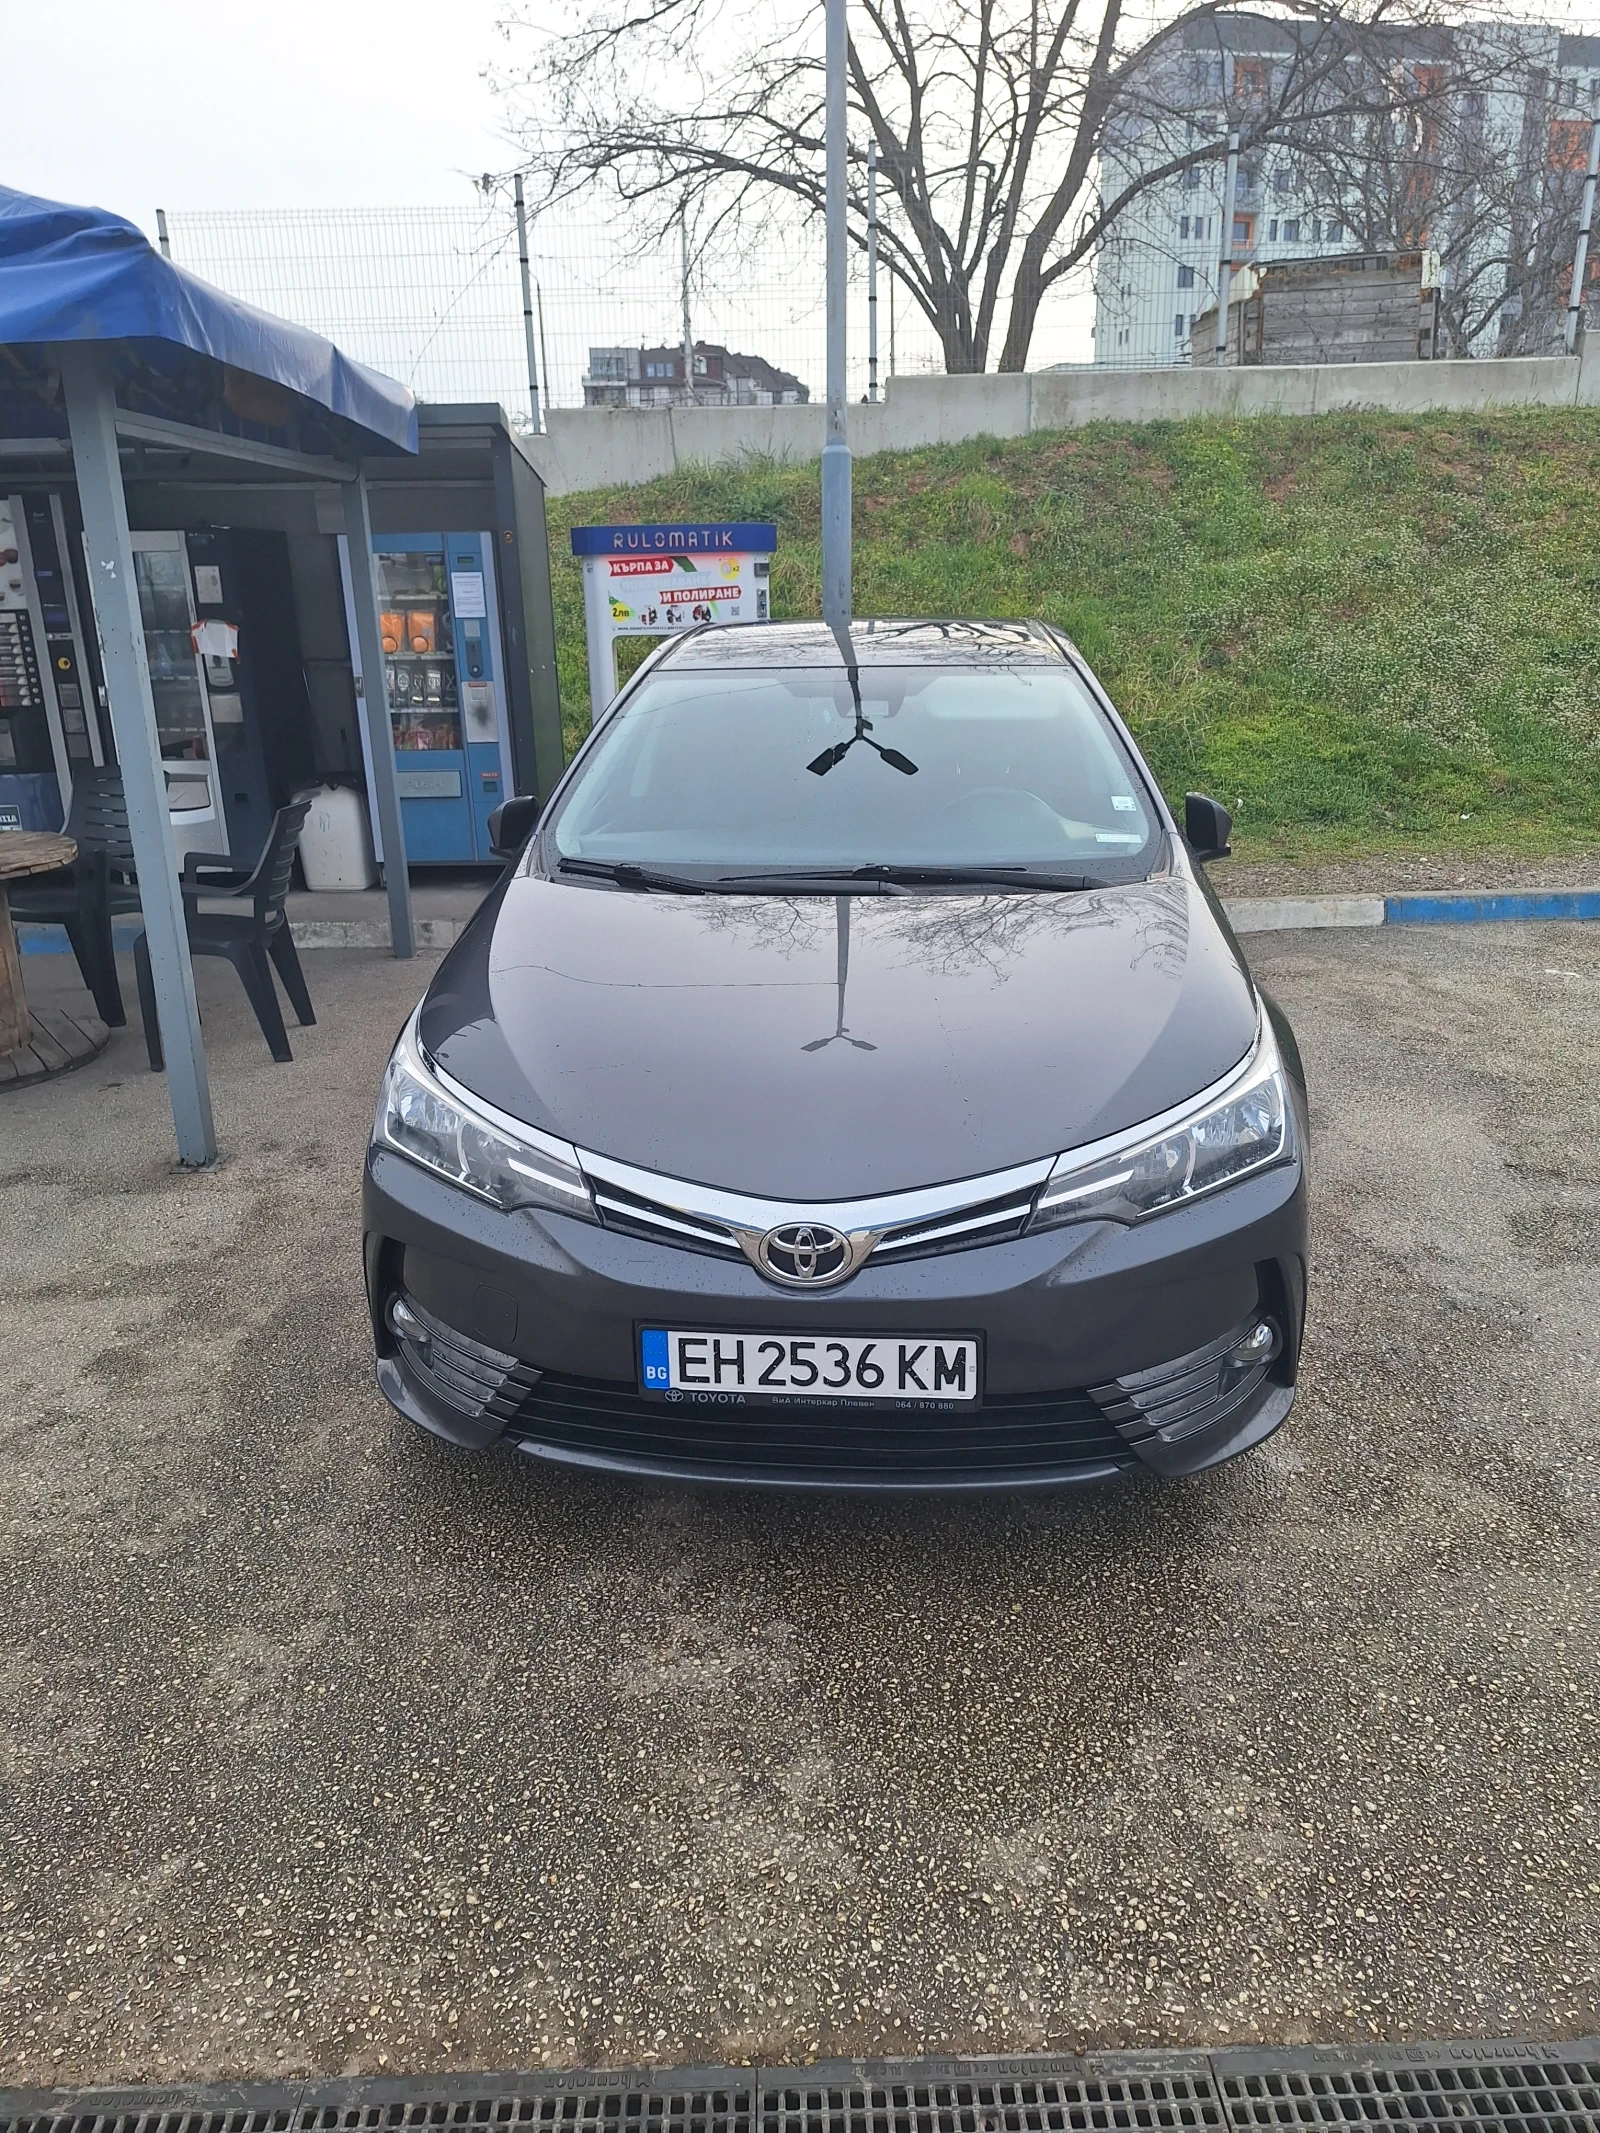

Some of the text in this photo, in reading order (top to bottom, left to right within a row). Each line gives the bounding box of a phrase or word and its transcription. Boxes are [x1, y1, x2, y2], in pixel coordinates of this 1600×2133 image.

[613, 531, 733, 548] RULOMATIK
[613, 560, 669, 573] КЪРПА ЗА
[663, 588, 740, 603] И ПОЛИРАНЕ
[406, 780, 442, 789] PUSH
[677, 1337, 968, 1392] EH 2536 KM
[646, 1365, 668, 1381] BG
[689, 1392, 746, 1404] TOYOTA
[793, 1397, 838, 1408] Интеркар
[840, 1399, 876, 1408] Плевен
[895, 1401, 912, 1410] 064
[919, 1401, 936, 1410] 870
[938, 1402, 955, 1411] 880
[1449, 2046, 1542, 2062] hauraton
[998, 2062, 1084, 2076] hauraton
